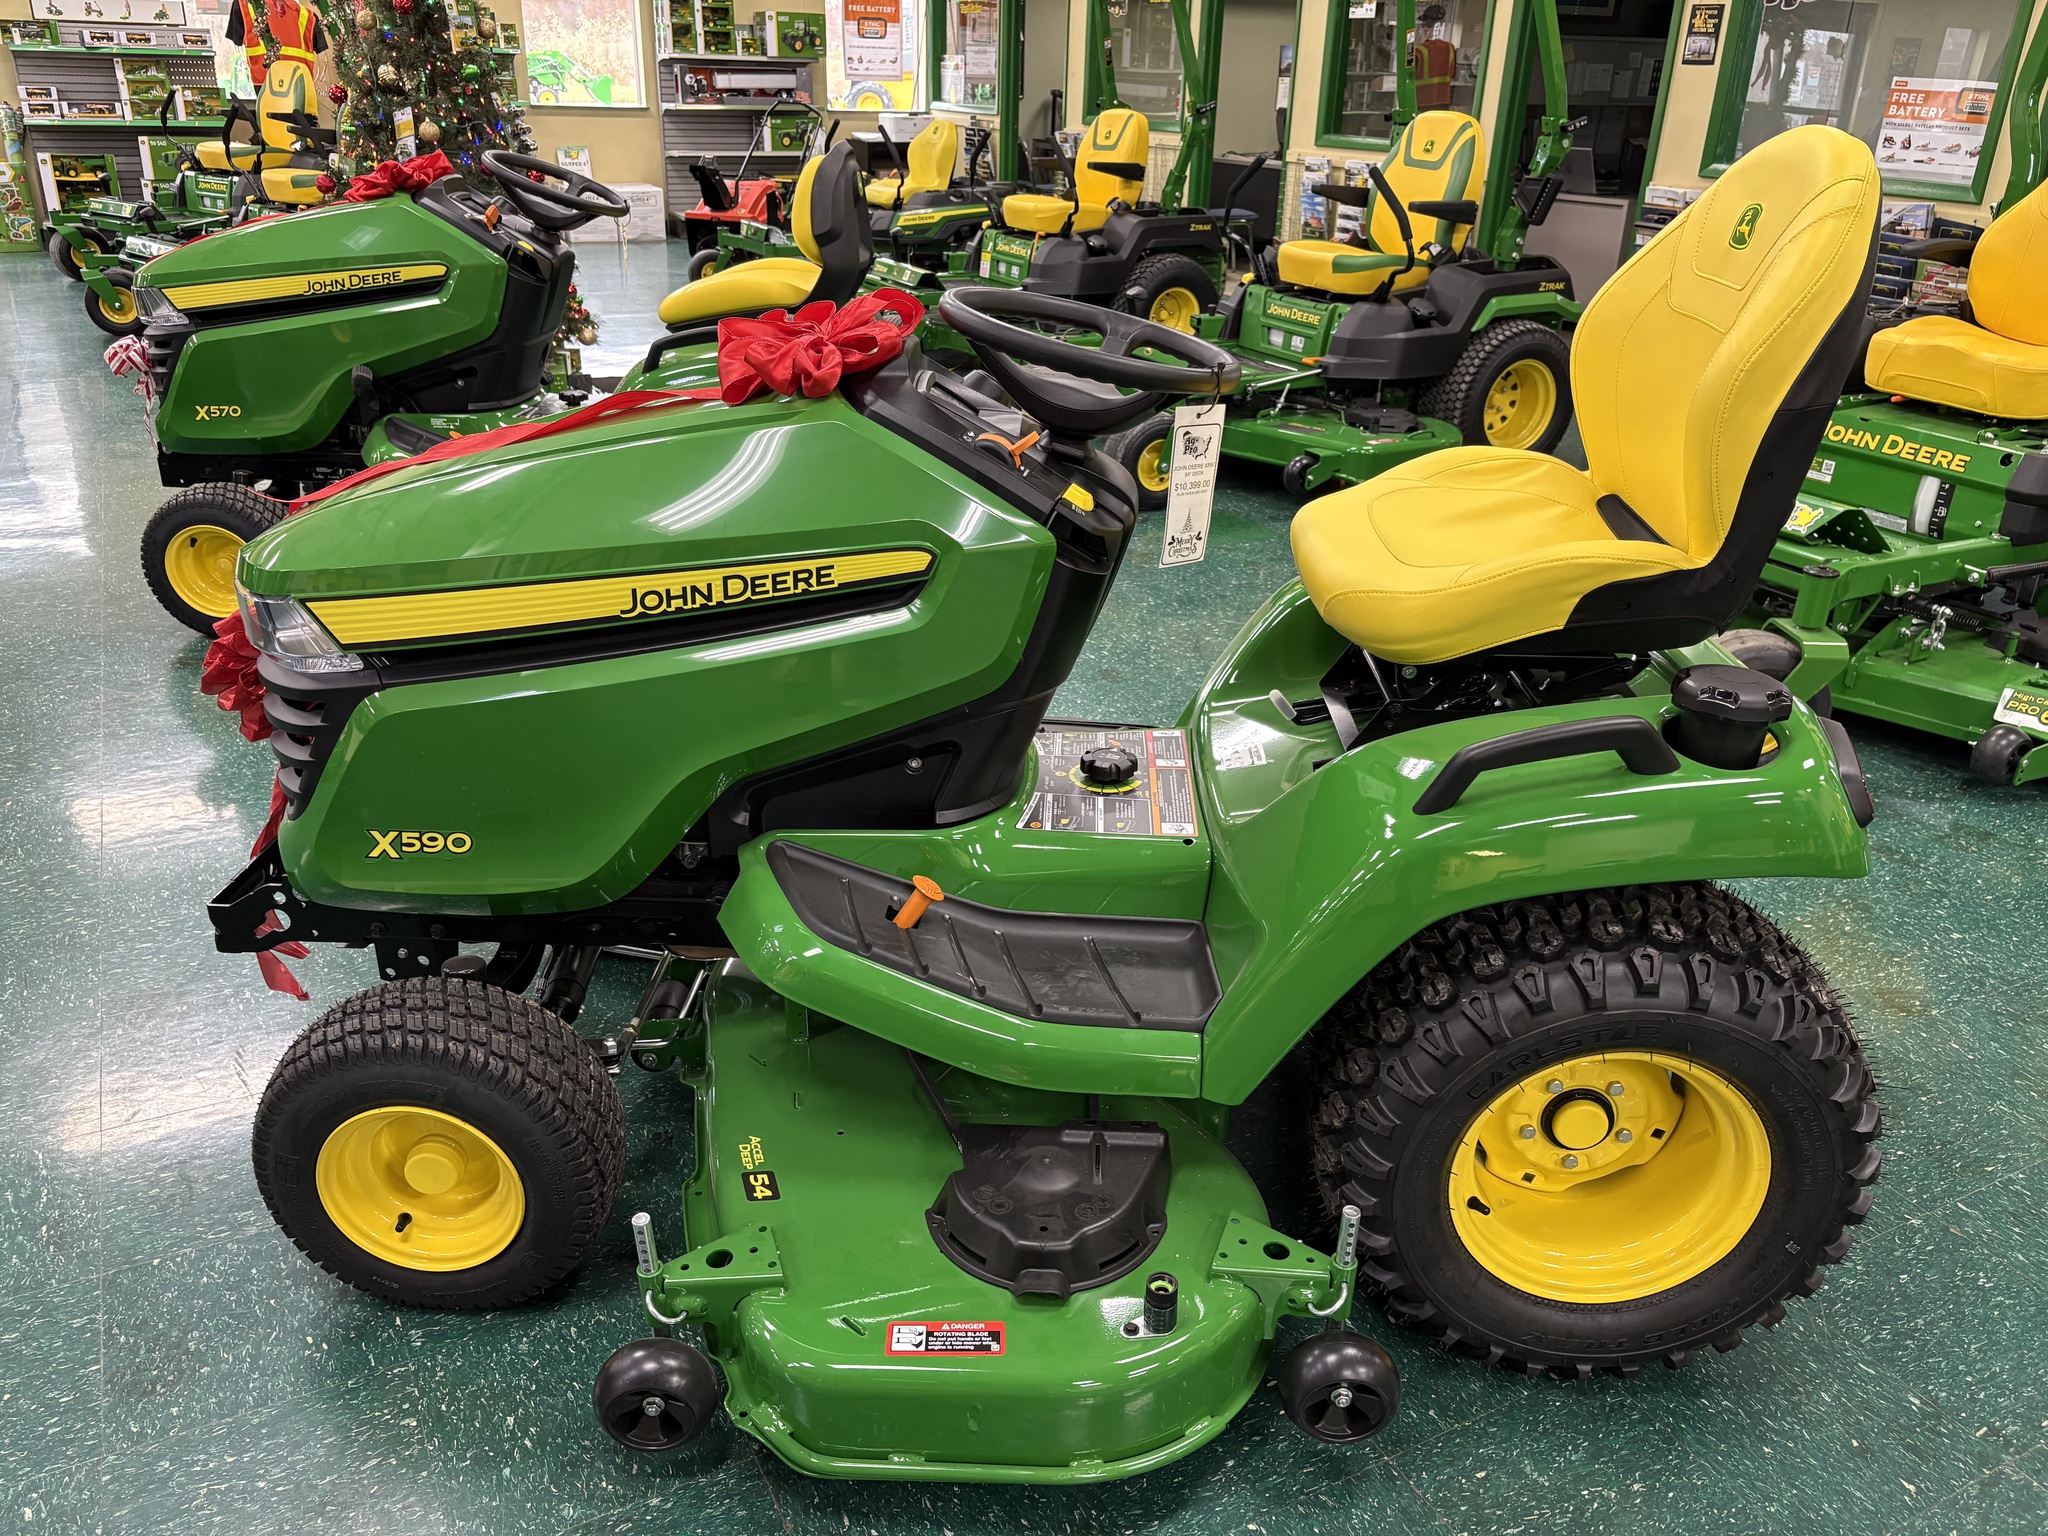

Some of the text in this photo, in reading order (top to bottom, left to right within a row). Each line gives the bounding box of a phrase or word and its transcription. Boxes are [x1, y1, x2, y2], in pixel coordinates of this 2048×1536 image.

[848, 4, 896, 13] FREE BATTERY
[1891, 92, 1925, 104] FREE
[1967, 93, 1991, 101] STIHL
[1888, 104, 1946, 118] BATTERY
[198, 181, 227, 191] JOHN DEERE
[1189, 223, 1212, 232] ZTRAK
[996, 242, 1027, 257] JOHN DEERE
[303, 271, 404, 295] JOHN DEERE
[1538, 281, 1566, 291] ZTRAK
[1267, 303, 1321, 325] JOHN DEERE
[194, 405, 242, 421] X570
[1823, 420, 1971, 473] JOHN DEERE
[1174, 479, 1211, 492] $10,399.00
[1175, 534, 1196, 547] MERRY
[1168, 542, 1197, 558] CHRISTMAS
[619, 564, 838, 618] JOHN DEERE
[2013, 691, 2035, 702] High
[2006, 700, 2041, 715] PRO
[366, 827, 474, 860] X590
[738, 1143, 754, 1170] DEEP
[748, 1135, 765, 1166] ACCEL
[749, 1173, 773, 1200] 54
